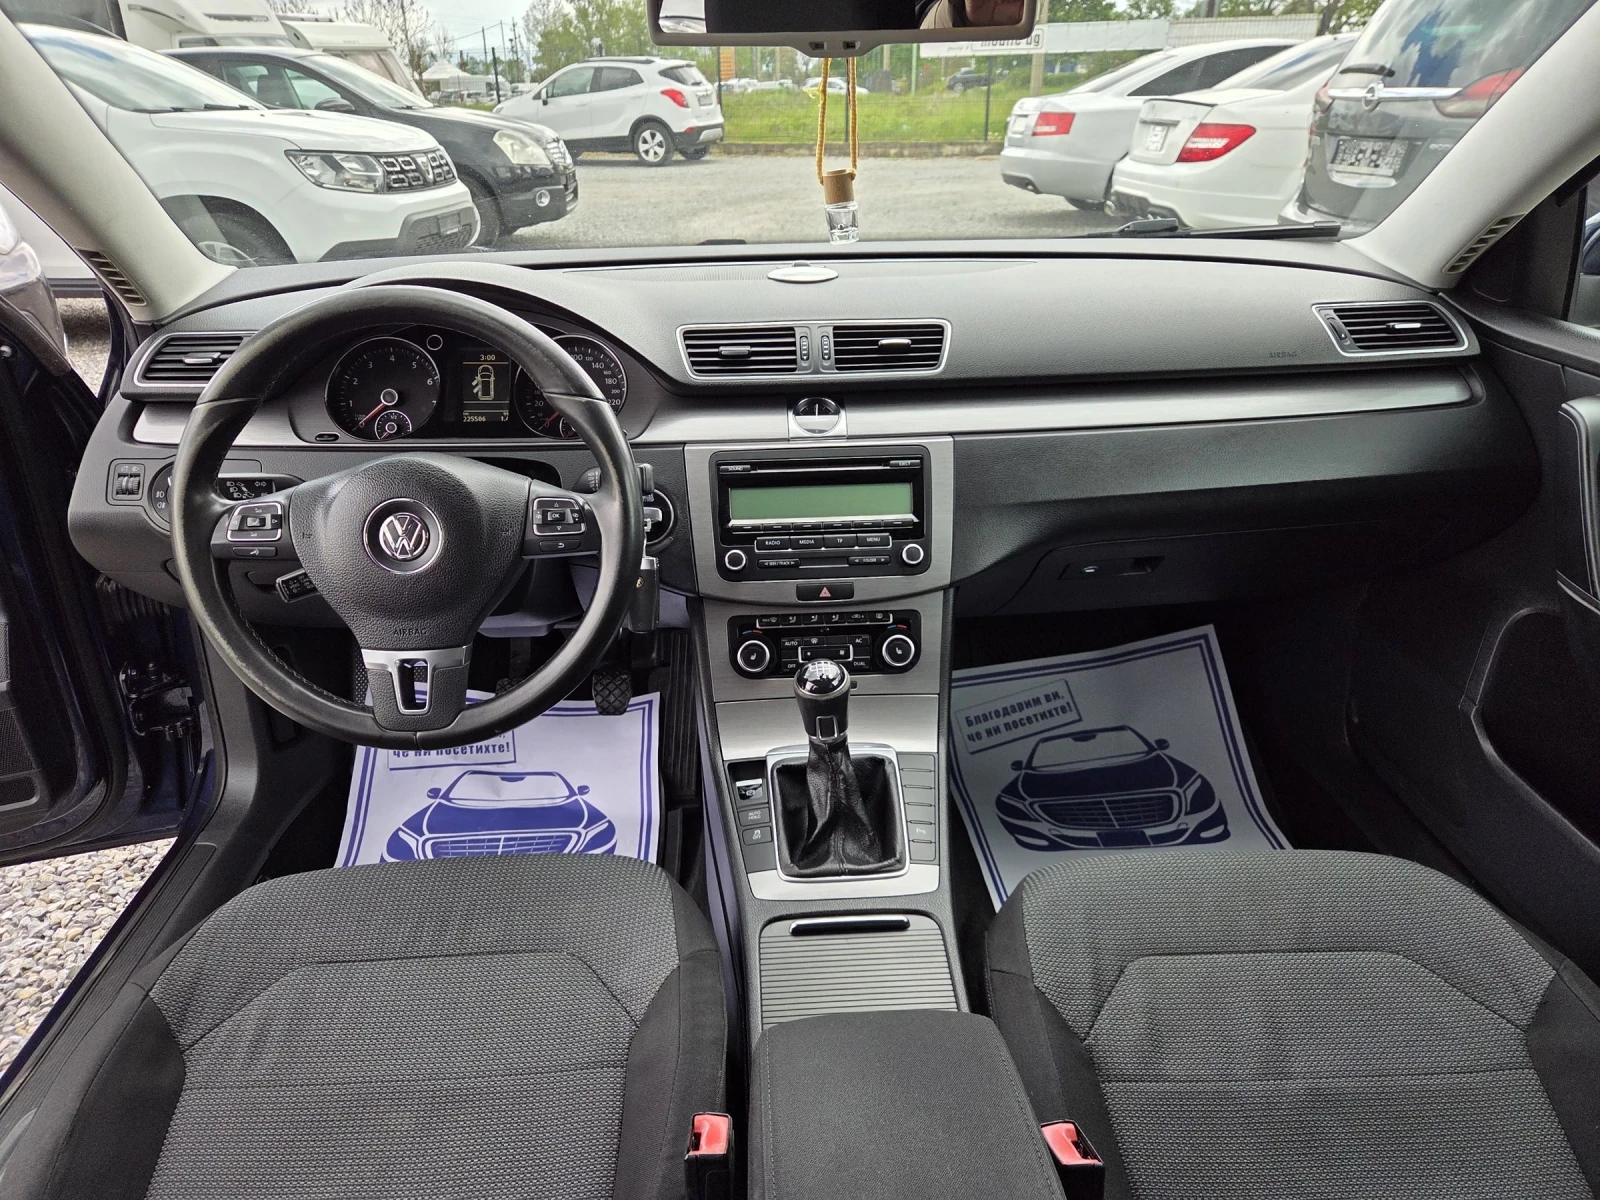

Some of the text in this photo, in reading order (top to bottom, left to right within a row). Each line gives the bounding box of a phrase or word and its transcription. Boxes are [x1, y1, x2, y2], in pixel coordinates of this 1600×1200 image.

[368, 361, 373, 369] 3
[412, 361, 417, 369] 5
[427, 378, 433, 386] 6
[608, 398, 621, 406] 220
[393, 628, 427, 637] AIRBAG
[965, 696, 1042, 727] Благодарим
[966, 702, 1073, 743] че ни посетихте!
[393, 748, 409, 758] че
[436, 741, 511, 756] посетихте!
